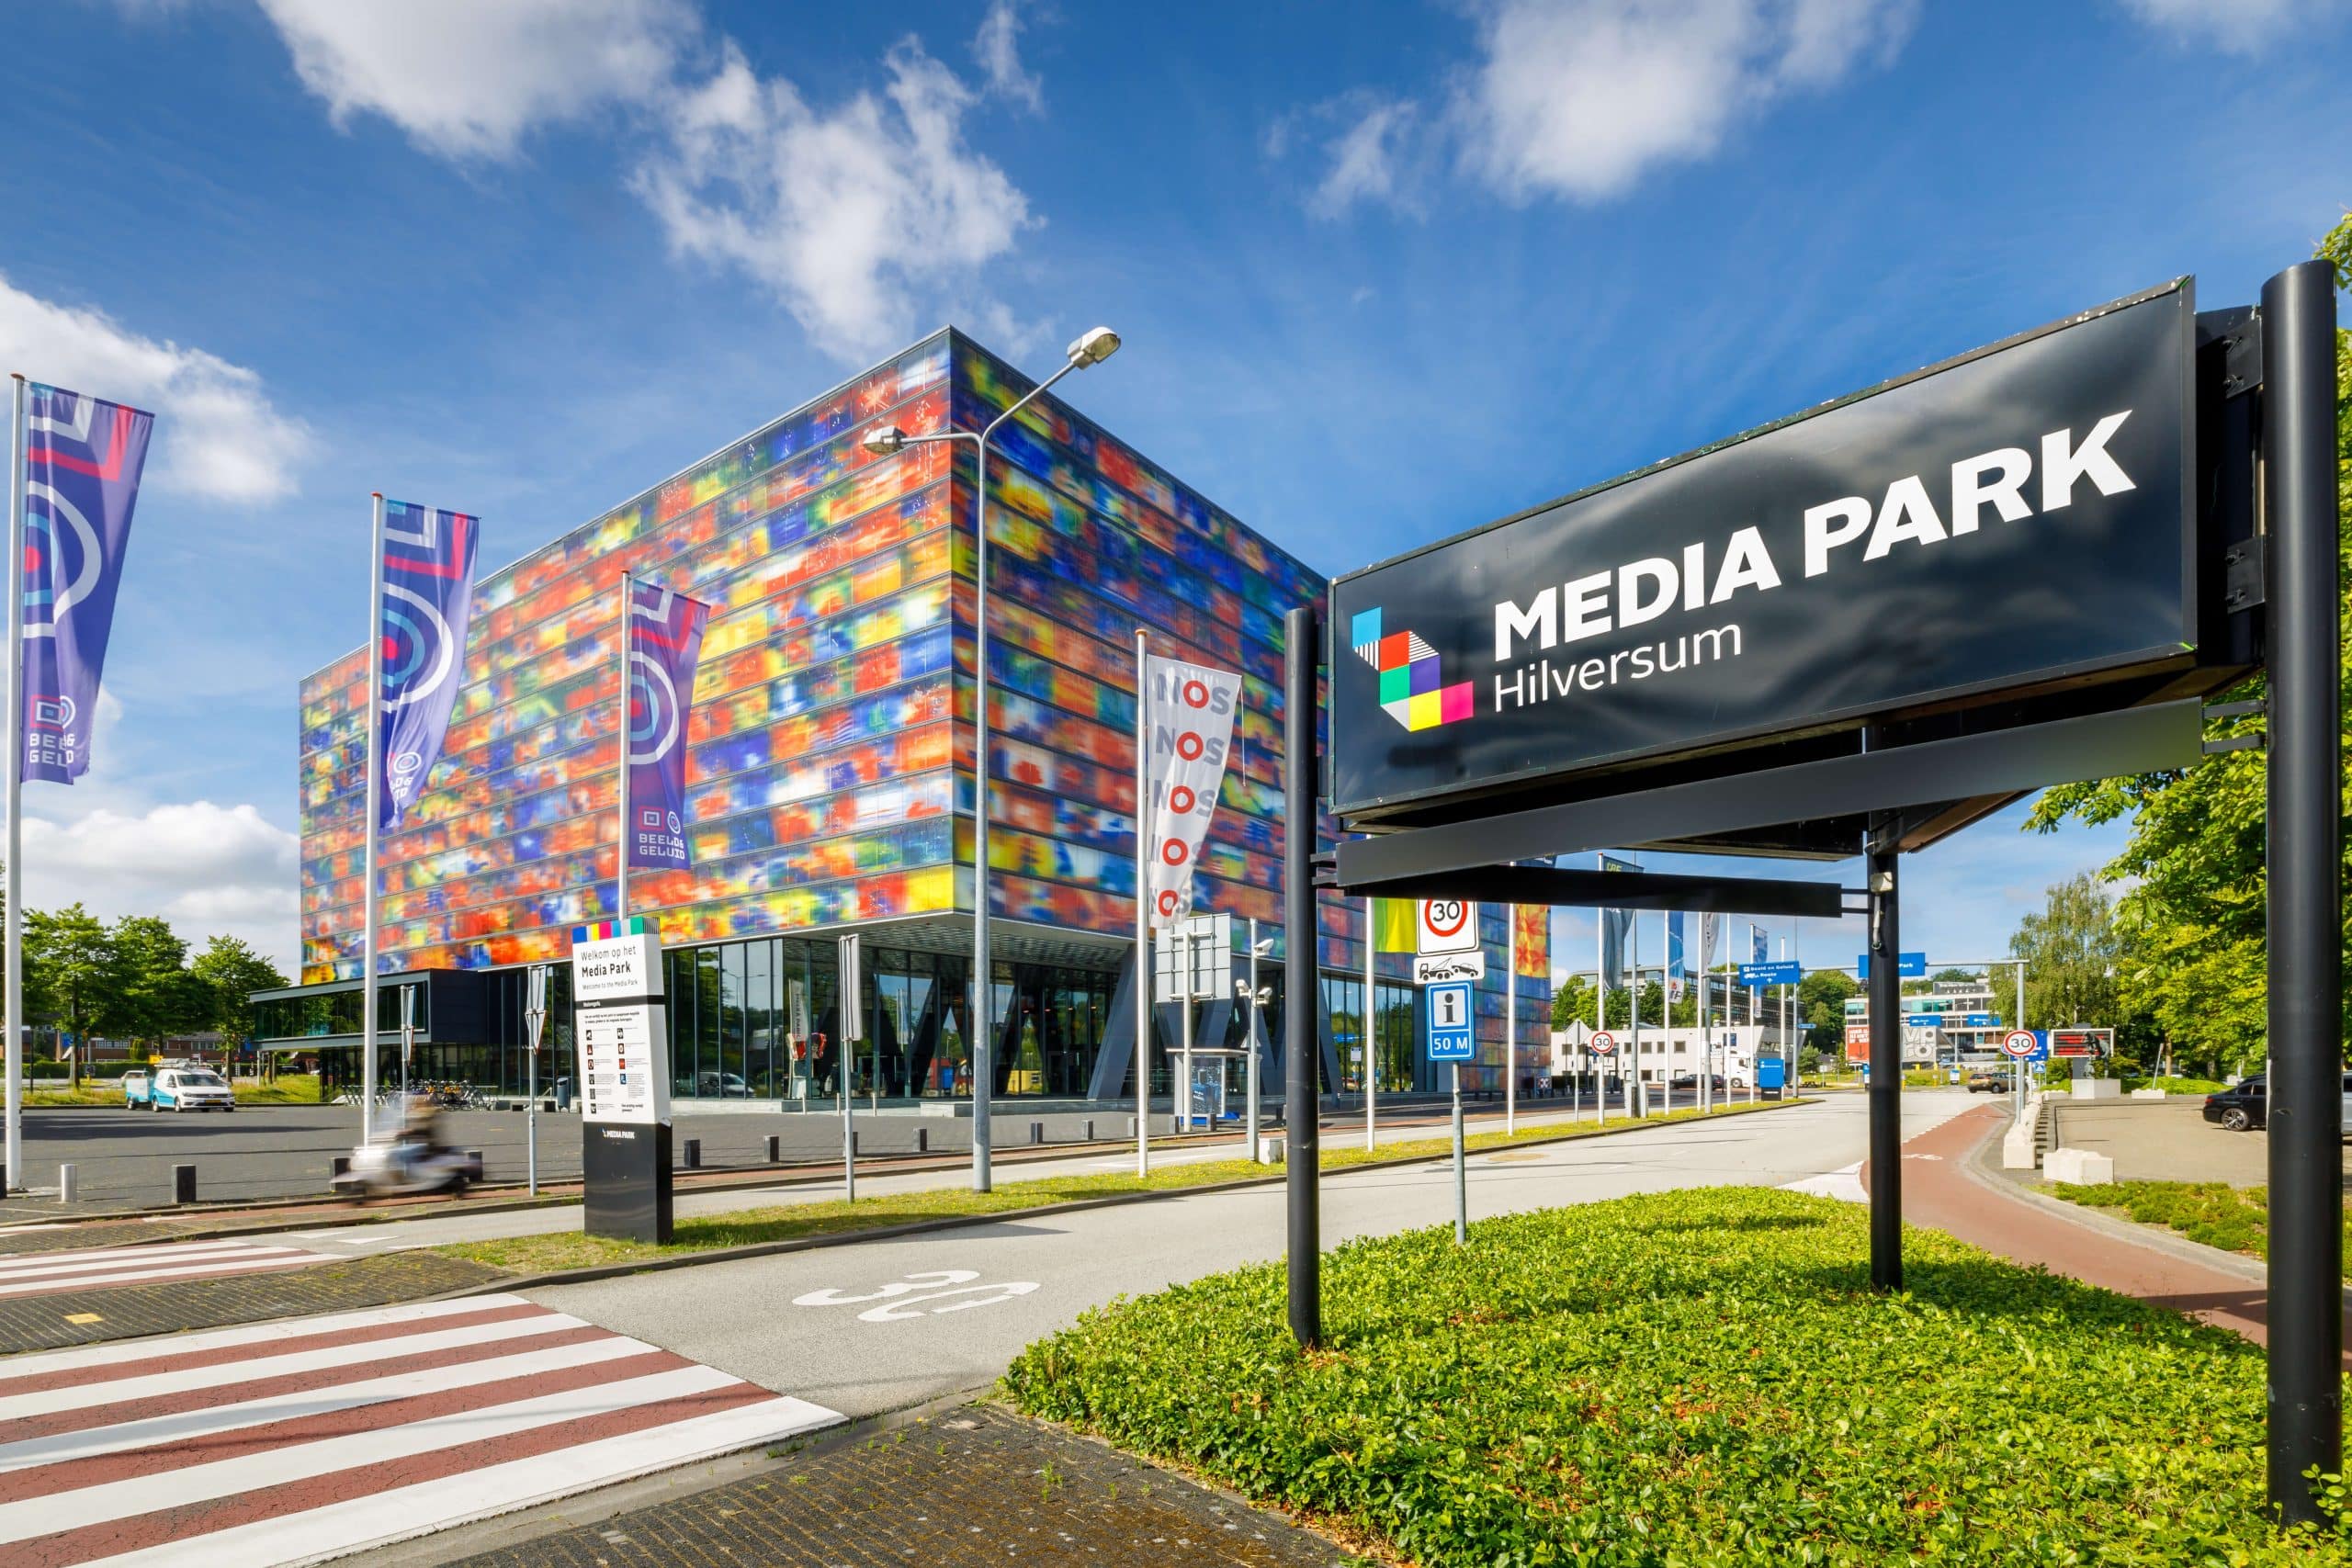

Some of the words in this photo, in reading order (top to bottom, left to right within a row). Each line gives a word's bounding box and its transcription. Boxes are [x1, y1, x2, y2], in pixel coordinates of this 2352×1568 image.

[1495, 525, 1781, 662] MEDIA
[1804, 409, 2137, 579] PARK
[1494, 624, 1742, 713] Hilversum
[1157, 672, 1231, 716] NOS
[1155, 725, 1225, 767] NOS
[1153, 779, 1217, 818] NOS
[639, 845, 685, 860] GELUID
[1433, 901, 1460, 922] 30
[581, 948, 609, 961] Welkom
[611, 948, 621, 959] op
[624, 945, 636, 955] het
[582, 964, 607, 977] Media
[610, 961, 631, 974] Park
[1434, 1037, 1451, 1051] 50
[1456, 1037, 1468, 1049] M
[1596, 1038, 1610, 1046] 30
[2010, 1038, 2030, 1048] 30
[791, 1269, 1042, 1322] 30
